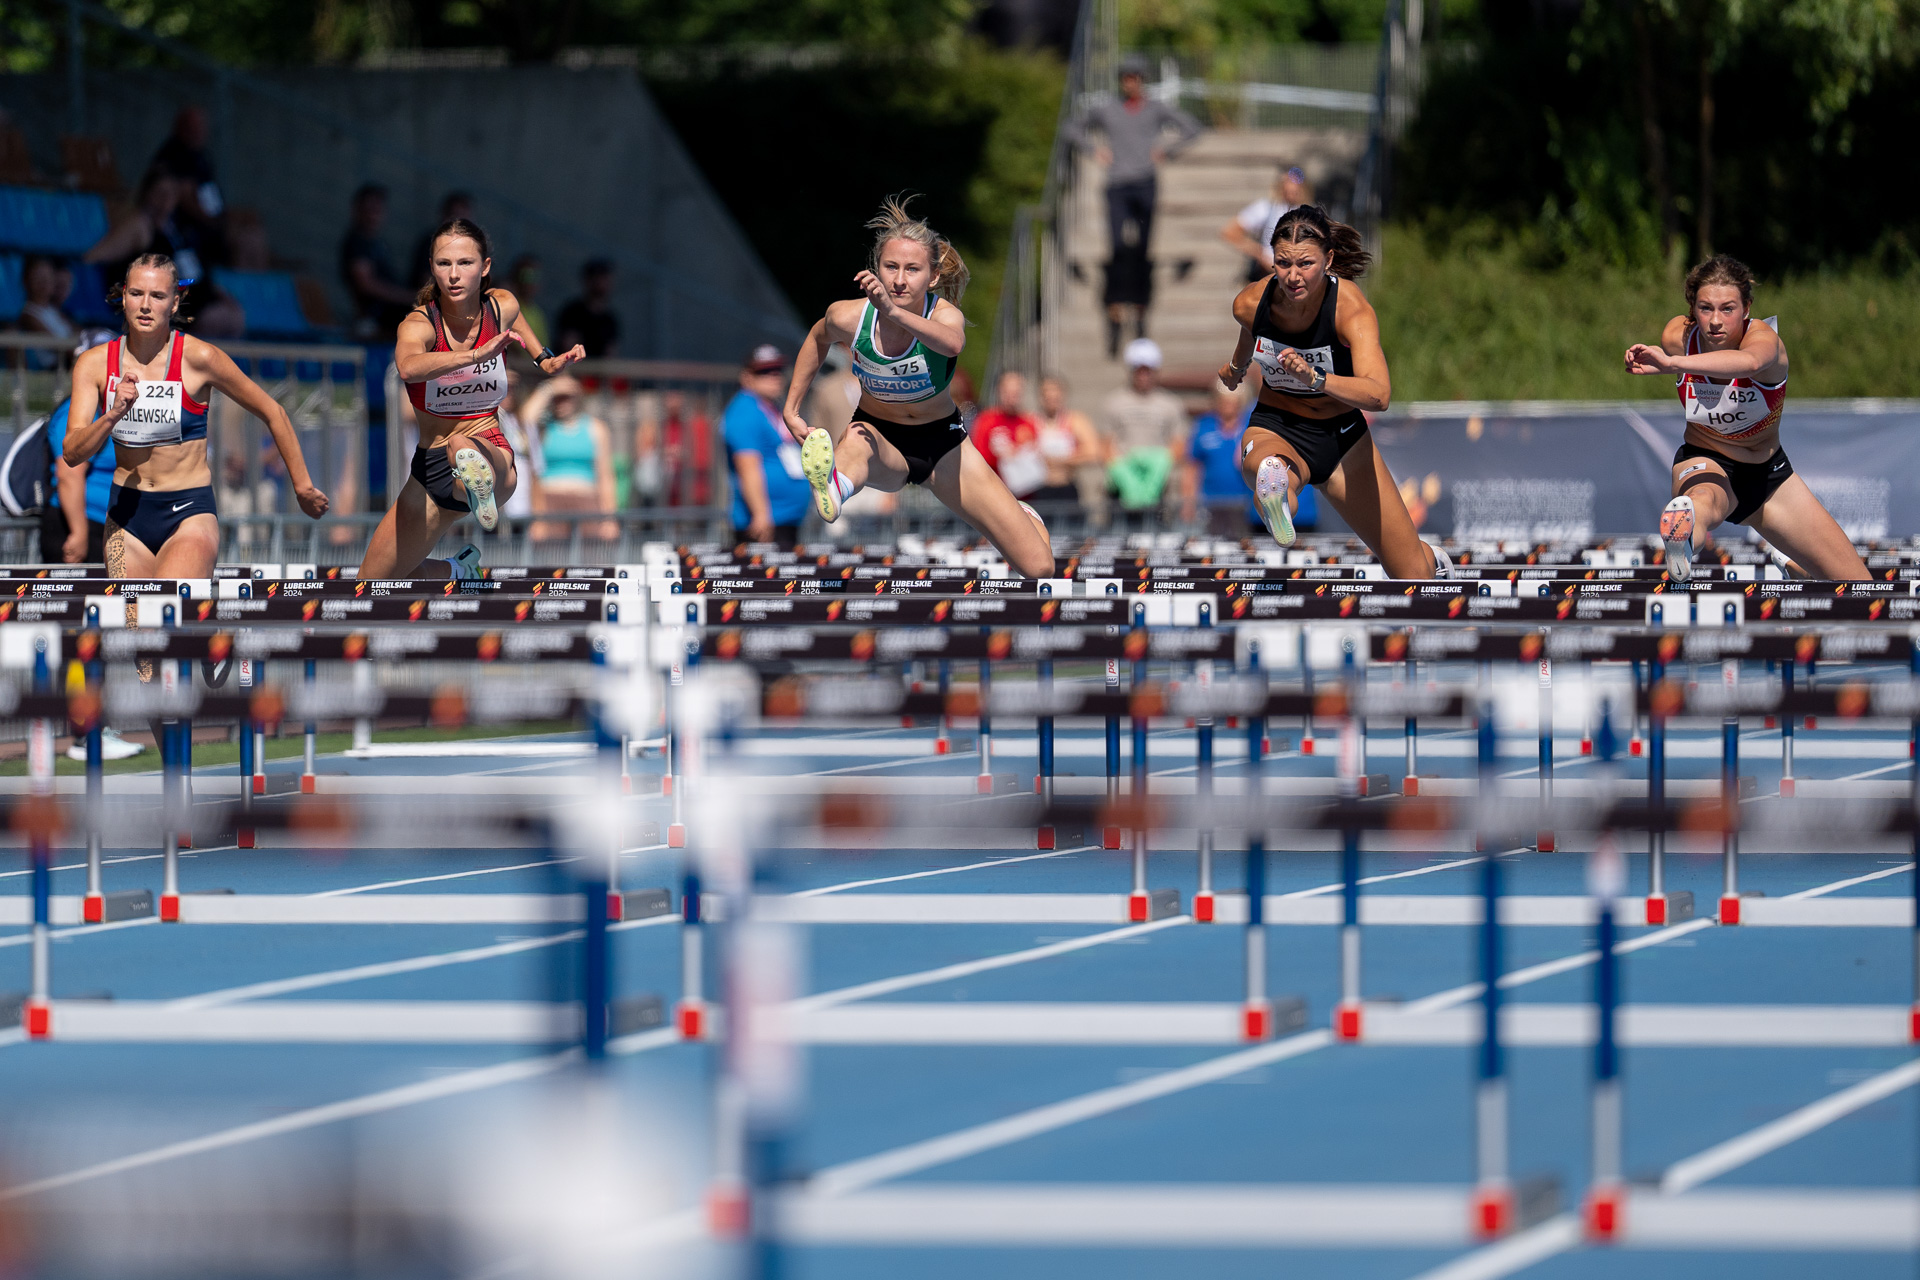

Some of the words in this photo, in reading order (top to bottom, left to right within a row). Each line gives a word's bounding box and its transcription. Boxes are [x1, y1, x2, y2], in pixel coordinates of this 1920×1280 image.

[473, 357, 497, 375] 459
[890, 361, 919, 376] 175
[145, 385, 174, 399] 224
[436, 380, 497, 397] KOZAN
[1728, 390, 1757, 403] 452
[109, 404, 176, 424] SILEWSKA
[1708, 411, 1747, 425] HOC
[32, 584, 74, 592] LUBELSKIE
[121, 584, 162, 592] LUBELSKIE
[283, 582, 325, 590] LUBELSKIE
[371, 581, 412, 589] LUBELSKIE
[460, 581, 502, 589] LUBELSKIE
[549, 582, 591, 591] LUBELSKIE
[712, 580, 754, 588] LUBELSKIE
[800, 580, 843, 588] LUBELSKIE
[890, 580, 932, 588] LUBELSKIE
[980, 580, 1022, 588] LUBELSKIE
[1153, 582, 1195, 590] LUBELSKIE
[1241, 583, 1282, 592] LUBELSKIE
[1580, 584, 1622, 592] LUBELSKIE
[1670, 583, 1712, 591] LUBELSKIE
[1761, 583, 1803, 592] LUBELSKIE
[1851, 582, 1894, 591] LUBELSKIE
[371, 588, 390, 597] 2024
[712, 588, 731, 596] 2024
[800, 588, 819, 596] 2024
[980, 588, 999, 596] 2024
[1331, 584, 1373, 593] LUBELSKIE
[1421, 584, 1463, 593] LUBELSKIE
[283, 590, 302, 598] 2024
[460, 589, 479, 597] 2024
[549, 590, 568, 598] 2024
[1761, 591, 1780, 599] 2024
[1851, 590, 1871, 598] 2024
